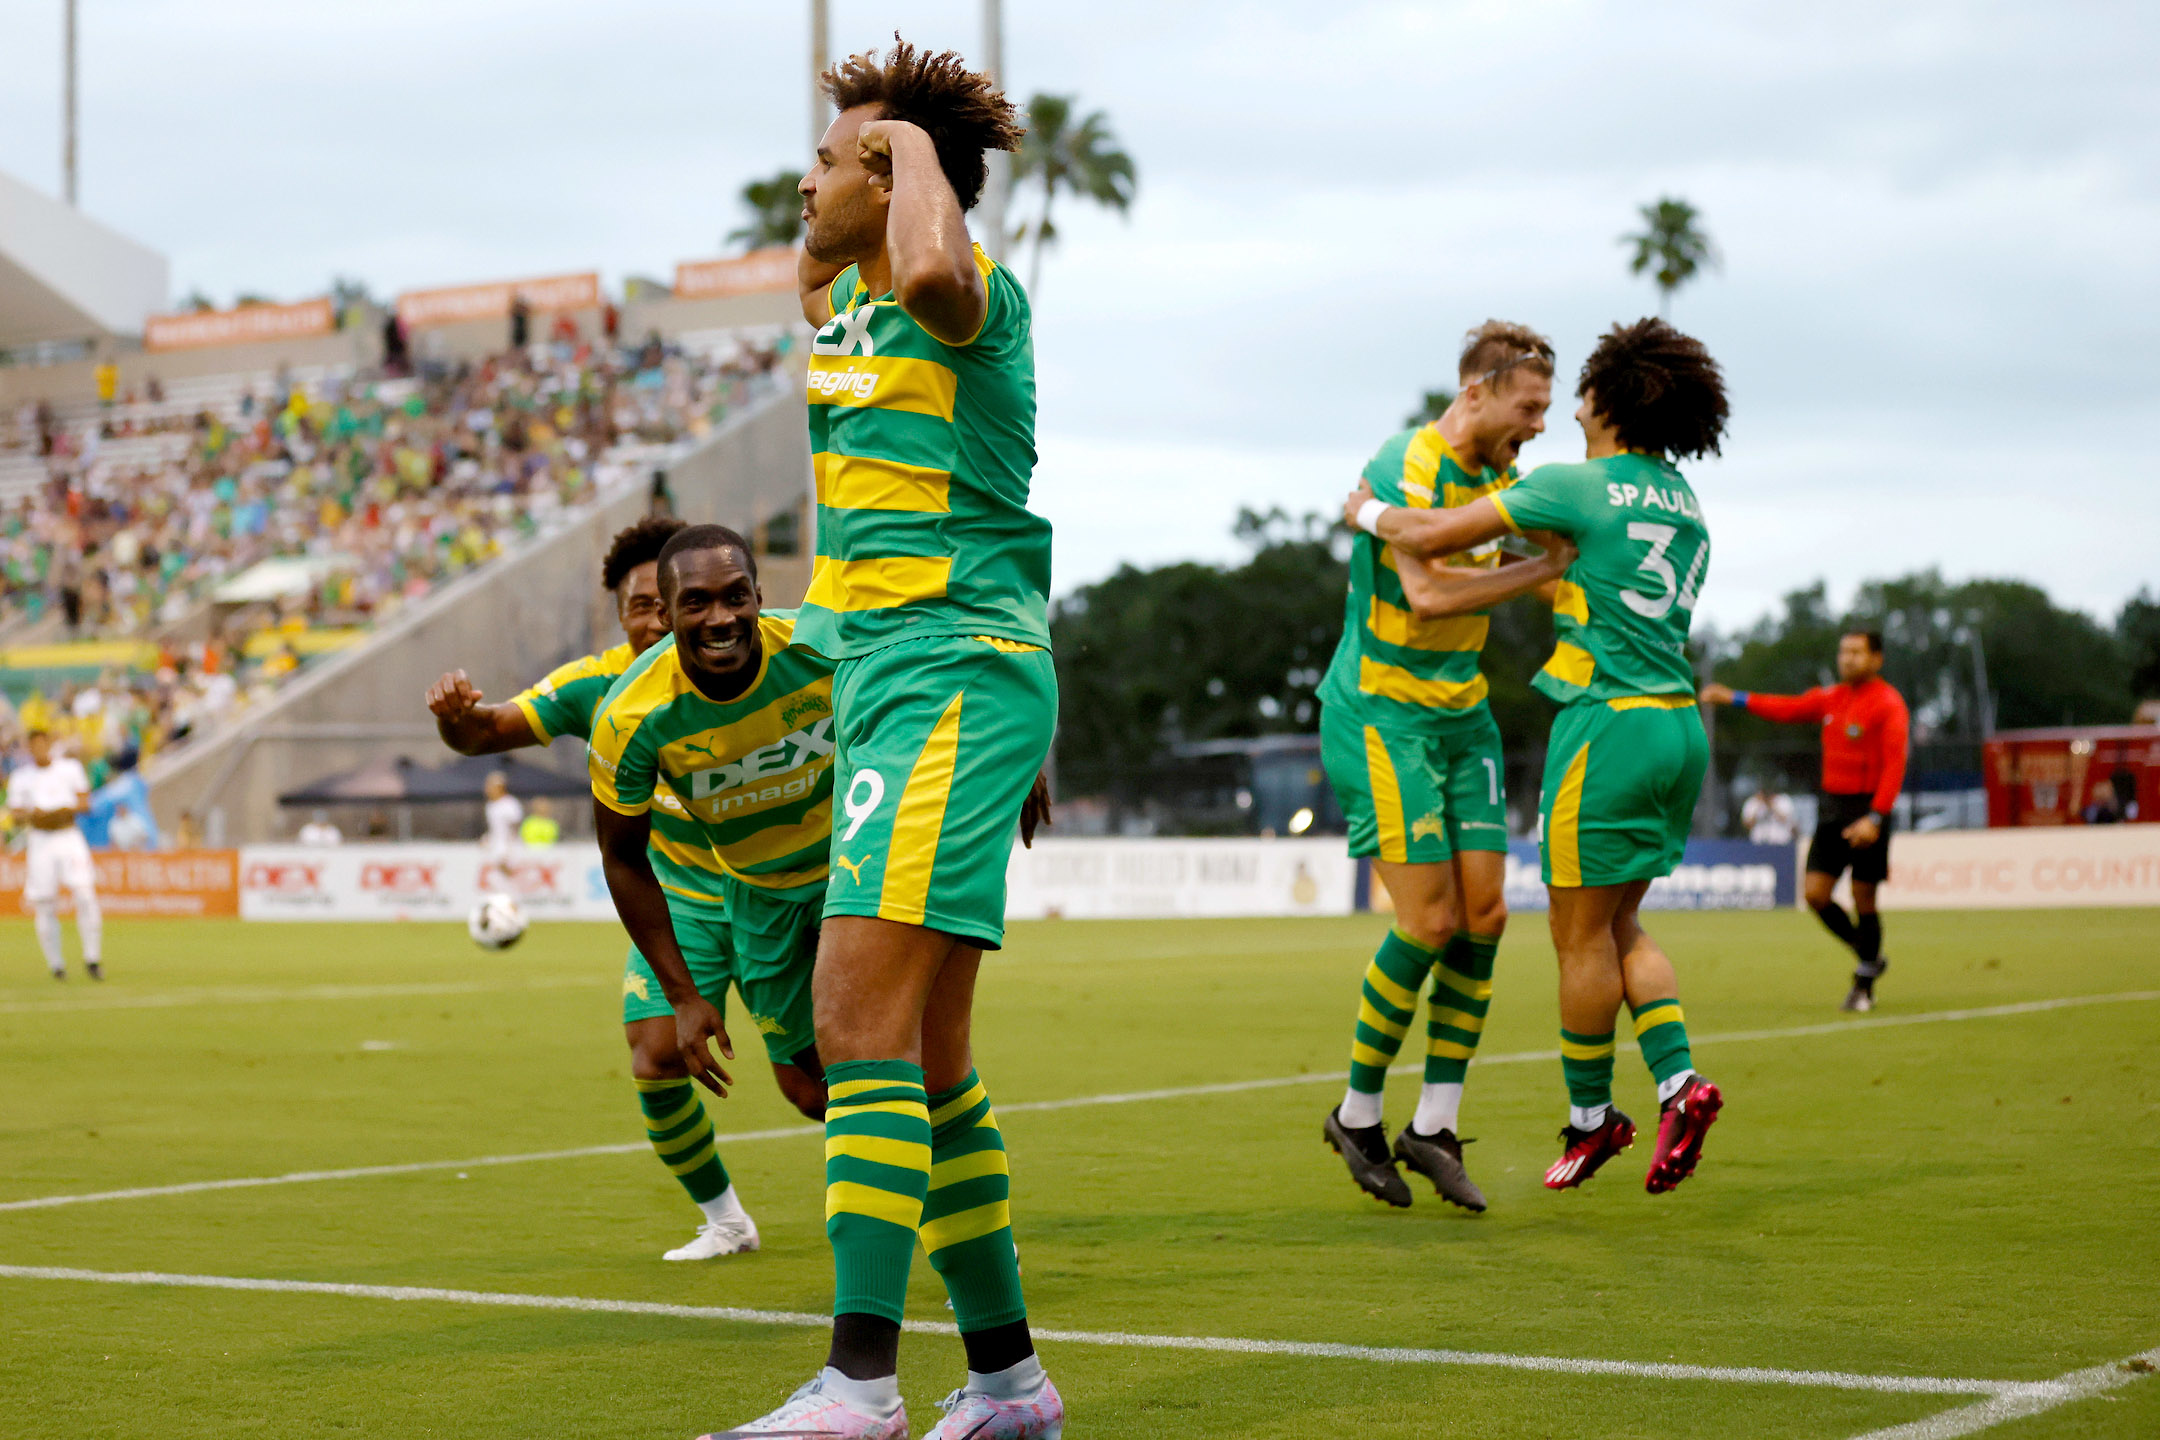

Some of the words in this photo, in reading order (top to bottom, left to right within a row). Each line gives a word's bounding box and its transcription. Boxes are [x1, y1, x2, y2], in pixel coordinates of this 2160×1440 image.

[807, 365, 880, 398] aging
[692, 715, 836, 800] DEX
[712, 765, 824, 815] imagi
[841, 768, 885, 842] 9
